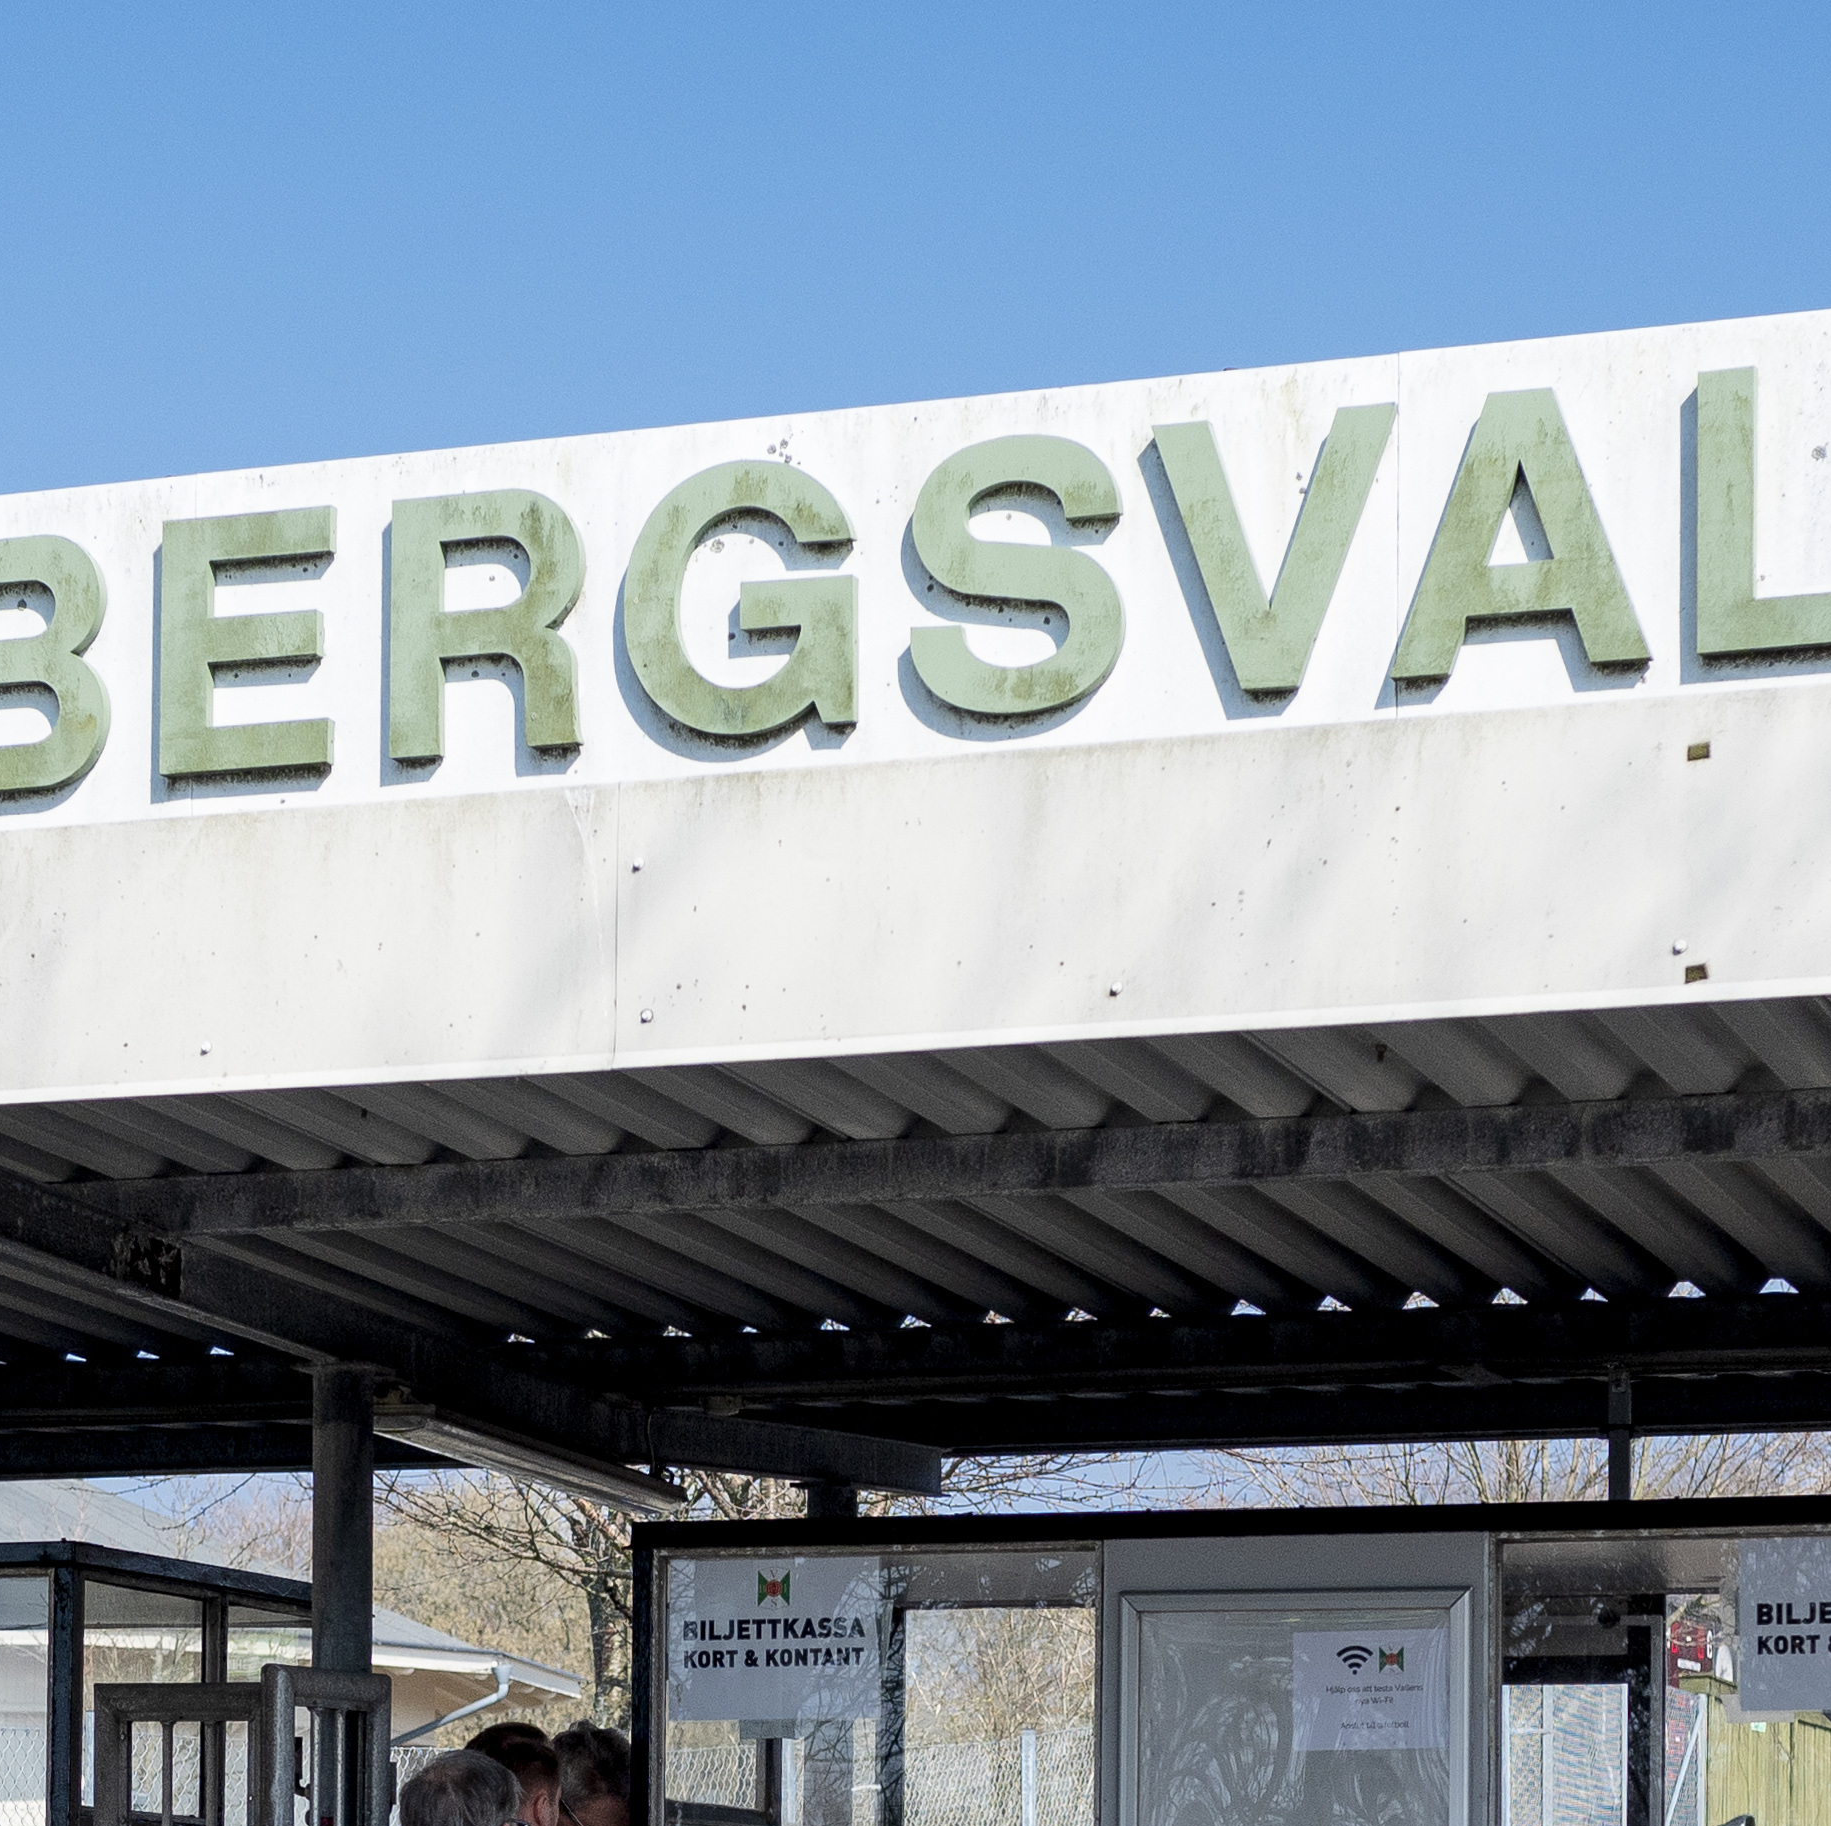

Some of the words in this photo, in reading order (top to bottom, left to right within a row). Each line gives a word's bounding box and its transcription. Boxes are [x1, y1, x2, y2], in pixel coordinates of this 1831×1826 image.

[683, 1617, 865, 1641] BILJETTKASSA
[1757, 1634, 1820, 1655] KORT
[684, 1650, 738, 1669] KORT
[744, 1649, 759, 1667] &
[766, 1647, 865, 1667] KONTANT
